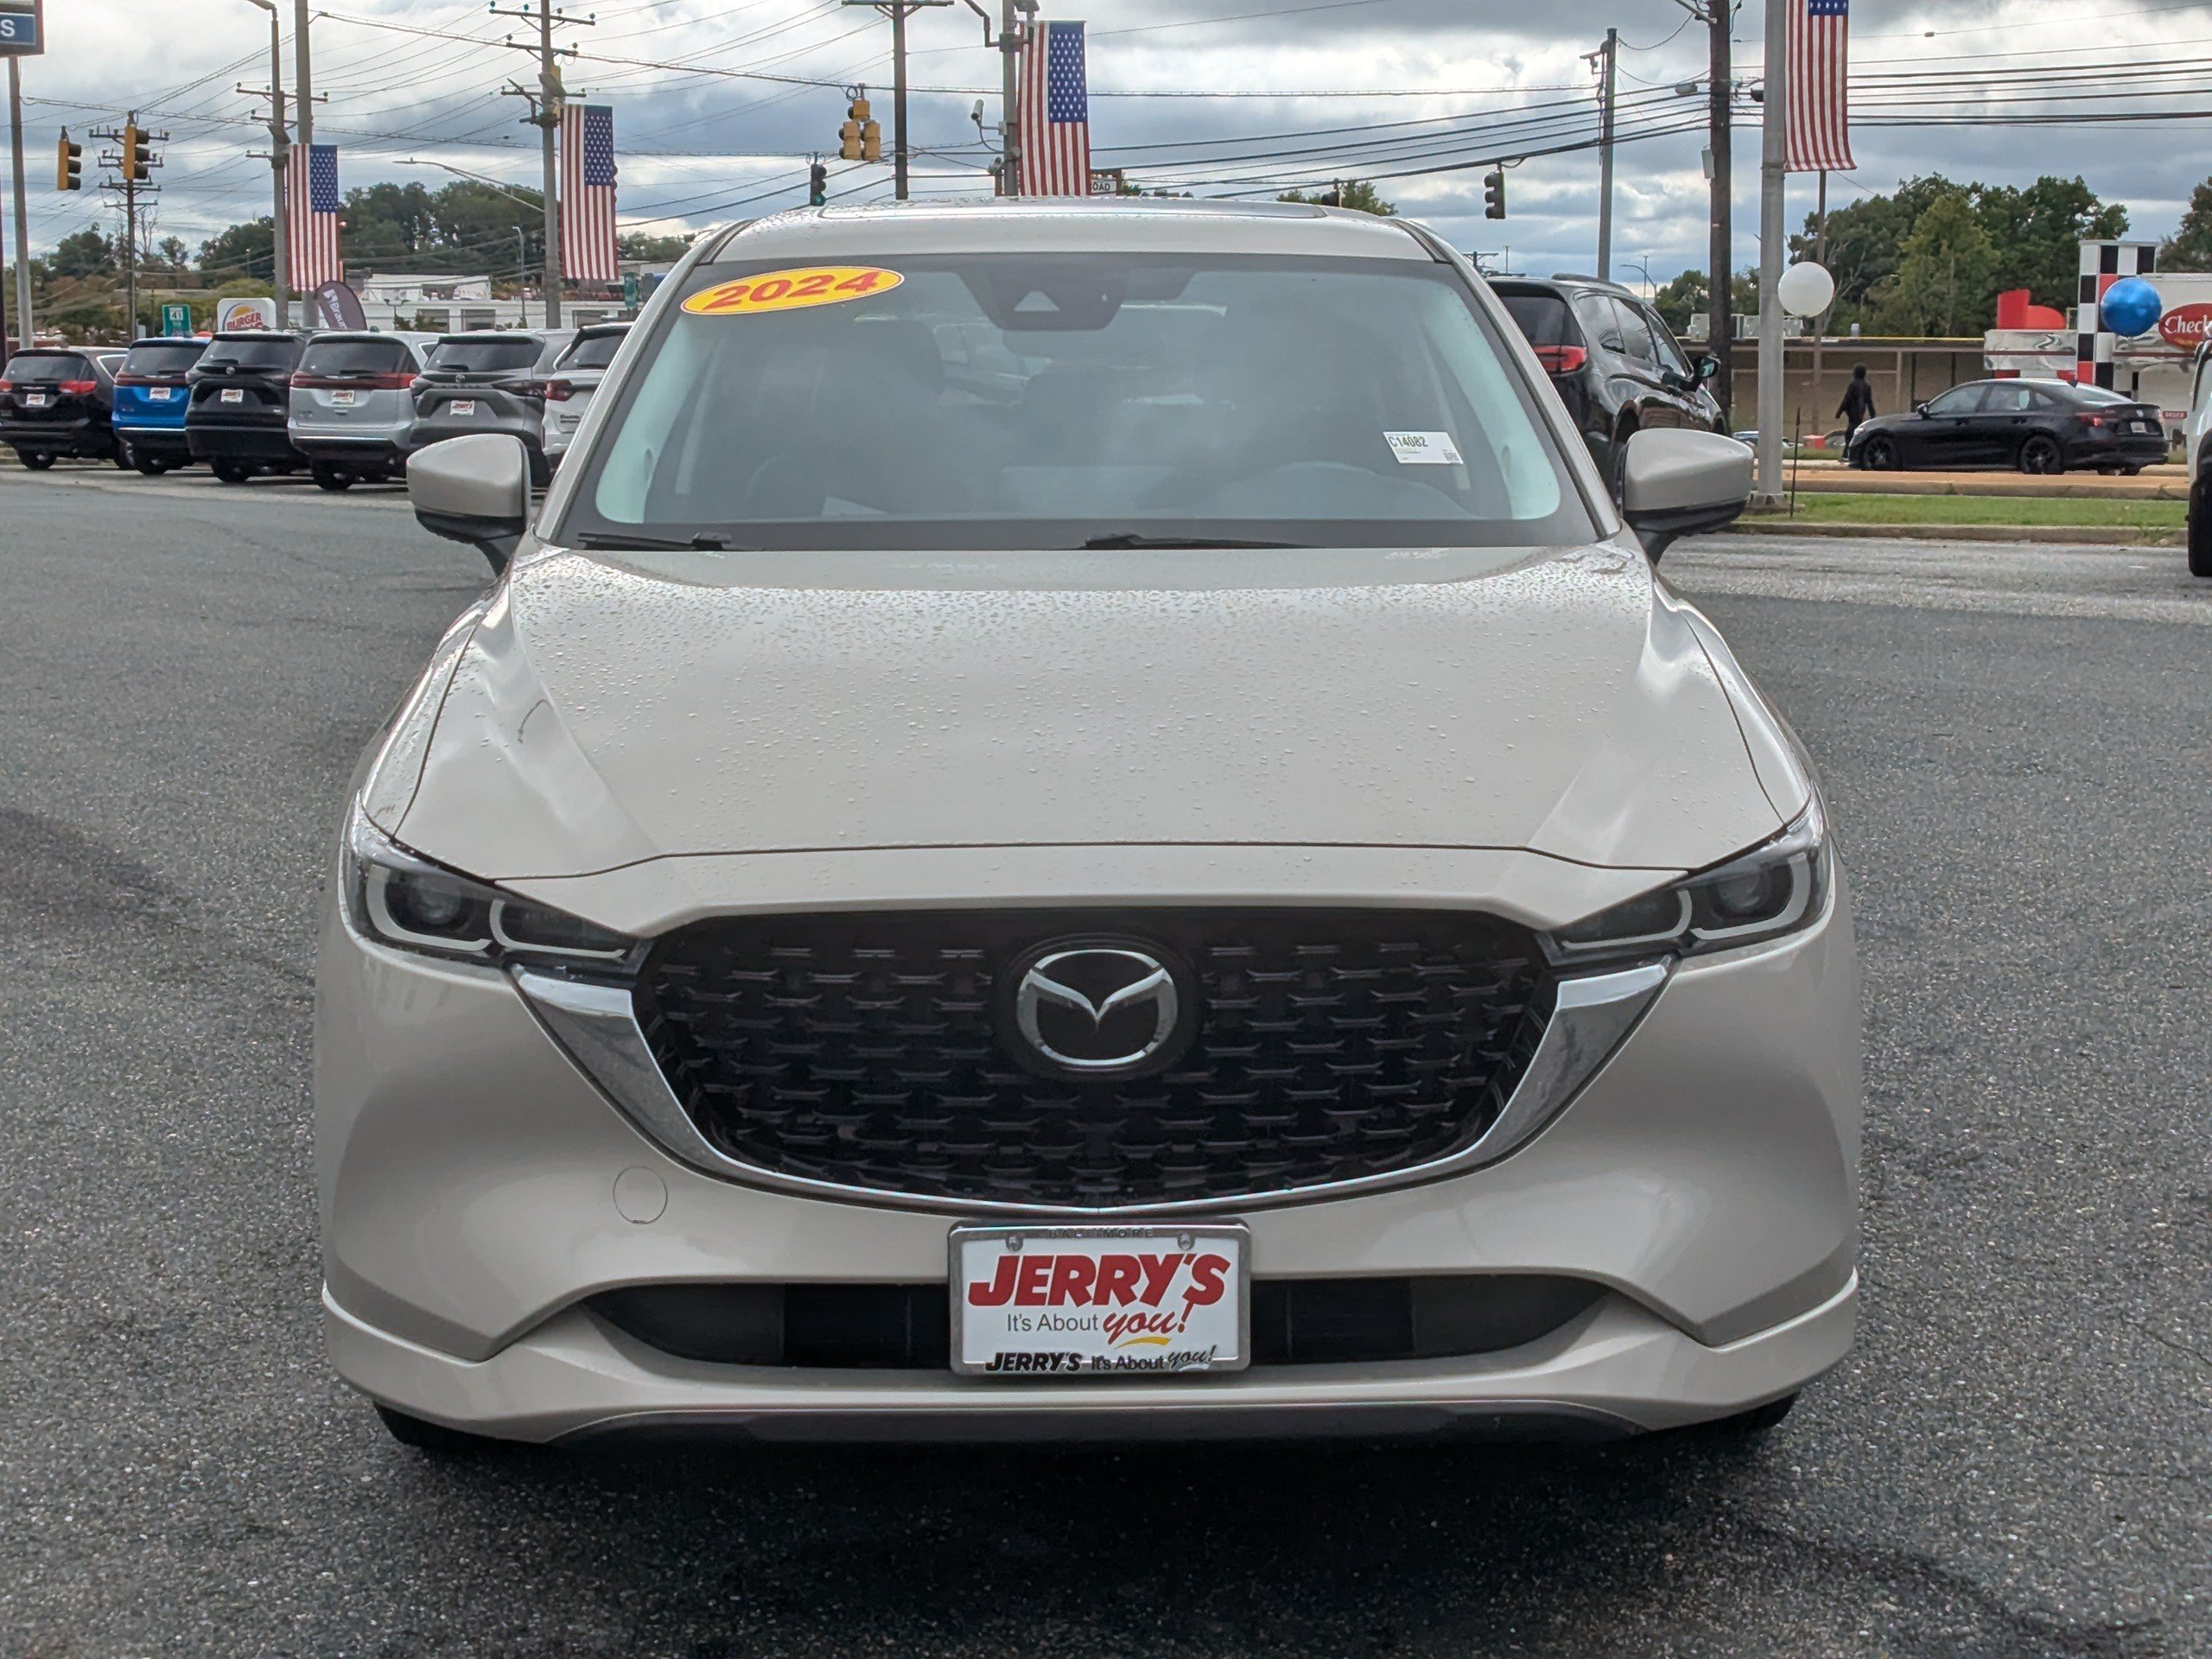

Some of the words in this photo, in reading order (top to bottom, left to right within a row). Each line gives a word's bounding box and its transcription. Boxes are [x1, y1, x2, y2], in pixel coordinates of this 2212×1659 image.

[1090, 180, 1111, 191] OAD
[702, 271, 882, 310] 2024
[226, 312, 262, 329] BURGER
[1388, 435, 1428, 448] C14082
[968, 1254, 1231, 1308] JERRY'S
[1007, 1313, 1032, 1332] It's
[1037, 1313, 1098, 1332] About
[1103, 1300, 1194, 1345] you!
[985, 1352, 1083, 1371] JERRY'S
[1091, 1355, 1111, 1370] It's
[1115, 1354, 1164, 1370] About
[1167, 1344, 1217, 1369] you!
